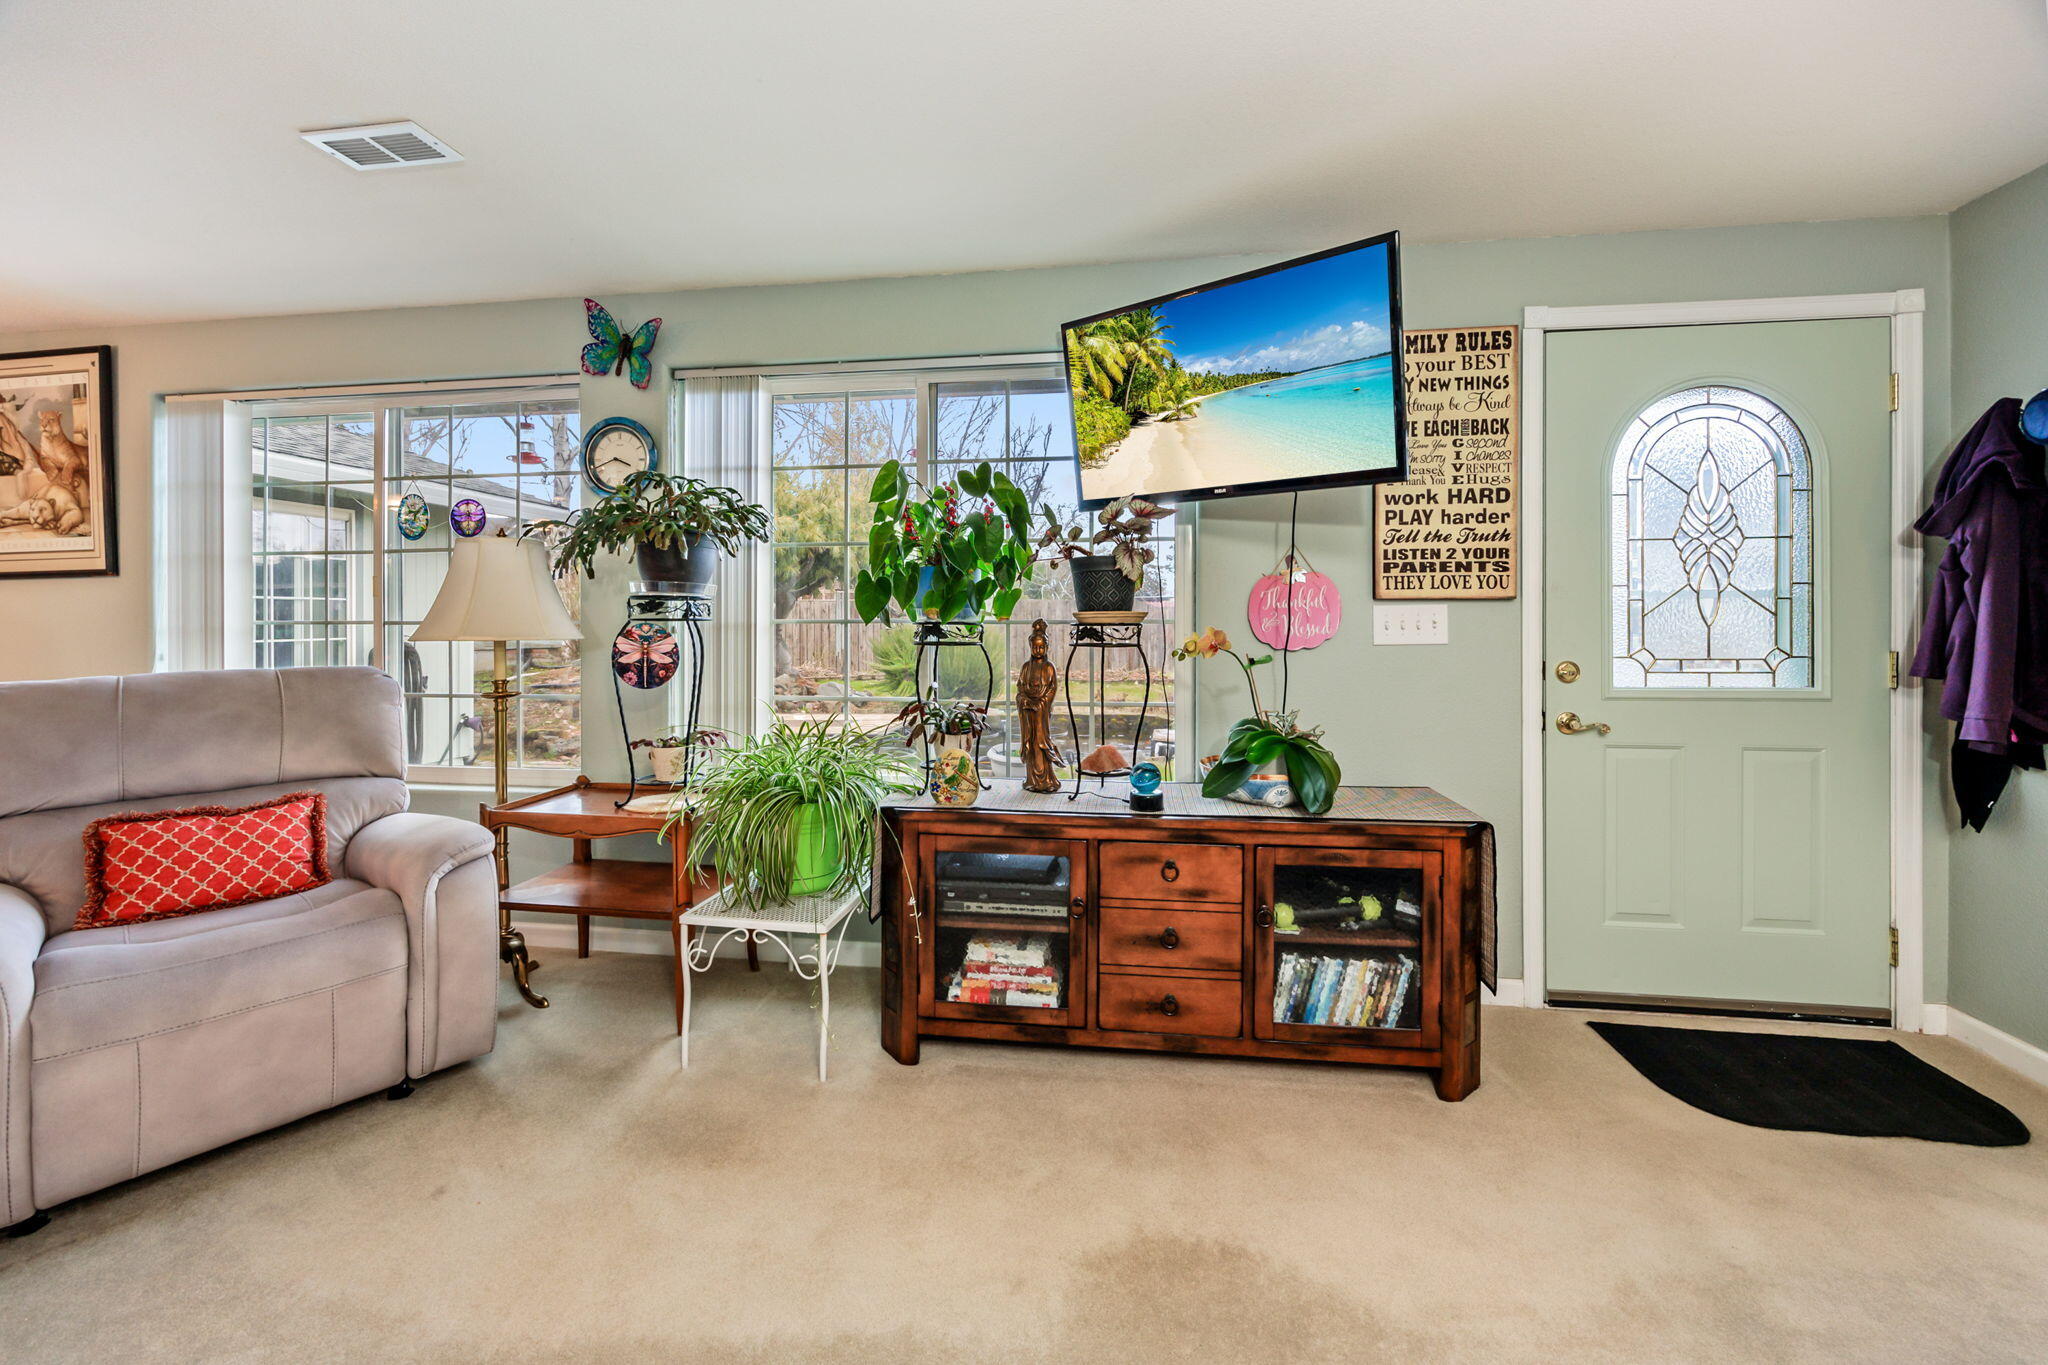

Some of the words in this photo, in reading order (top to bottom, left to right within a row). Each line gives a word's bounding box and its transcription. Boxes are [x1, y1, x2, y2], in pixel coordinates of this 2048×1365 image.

[1405, 333, 1448, 354] MILY
[1456, 330, 1512, 352] RULES
[1415, 360, 1456, 378] your
[1461, 353, 1510, 371] BEST
[1418, 377, 1451, 392] NEW
[1455, 375, 1510, 391] THINGS
[1449, 396, 1461, 411] be
[1464, 391, 1511, 412] Kind
[1424, 420, 1460, 437] EACH
[1471, 418, 1510, 436] BACK
[1409, 440, 1429, 450] Love
[1432, 439, 1448, 454] You
[1466, 435, 1508, 449] second
[1420, 454, 1446, 468] sorry
[1466, 448, 1511, 461] chances
[1409, 465, 1437, 475] lease
[1466, 463, 1512, 474] RESPECT
[1430, 475, 1446, 485] You
[1467, 474, 1511, 486] Hugs
[1384, 489, 1439, 505] work
[1448, 487, 1511, 504] HARD
[1385, 509, 1434, 525] PLAY
[1441, 508, 1510, 525] harder
[1383, 528, 1421, 546] Tell
[1423, 530, 1452, 543] the
[1456, 527, 1512, 544] Truth
[1383, 548, 1441, 560] LISTEN
[1446, 548, 1456, 560] 2
[1461, 548, 1510, 560] YOUR
[1383, 561, 1510, 573] PARENTS
[1383, 575, 1426, 590] THEY
[1430, 575, 1472, 590] LOVE
[1474, 575, 1511, 590] YOU
[1260, 585, 1327, 616] Thankful
[1261, 611, 1281, 632] &
[1282, 612, 1332, 639] Blessed
